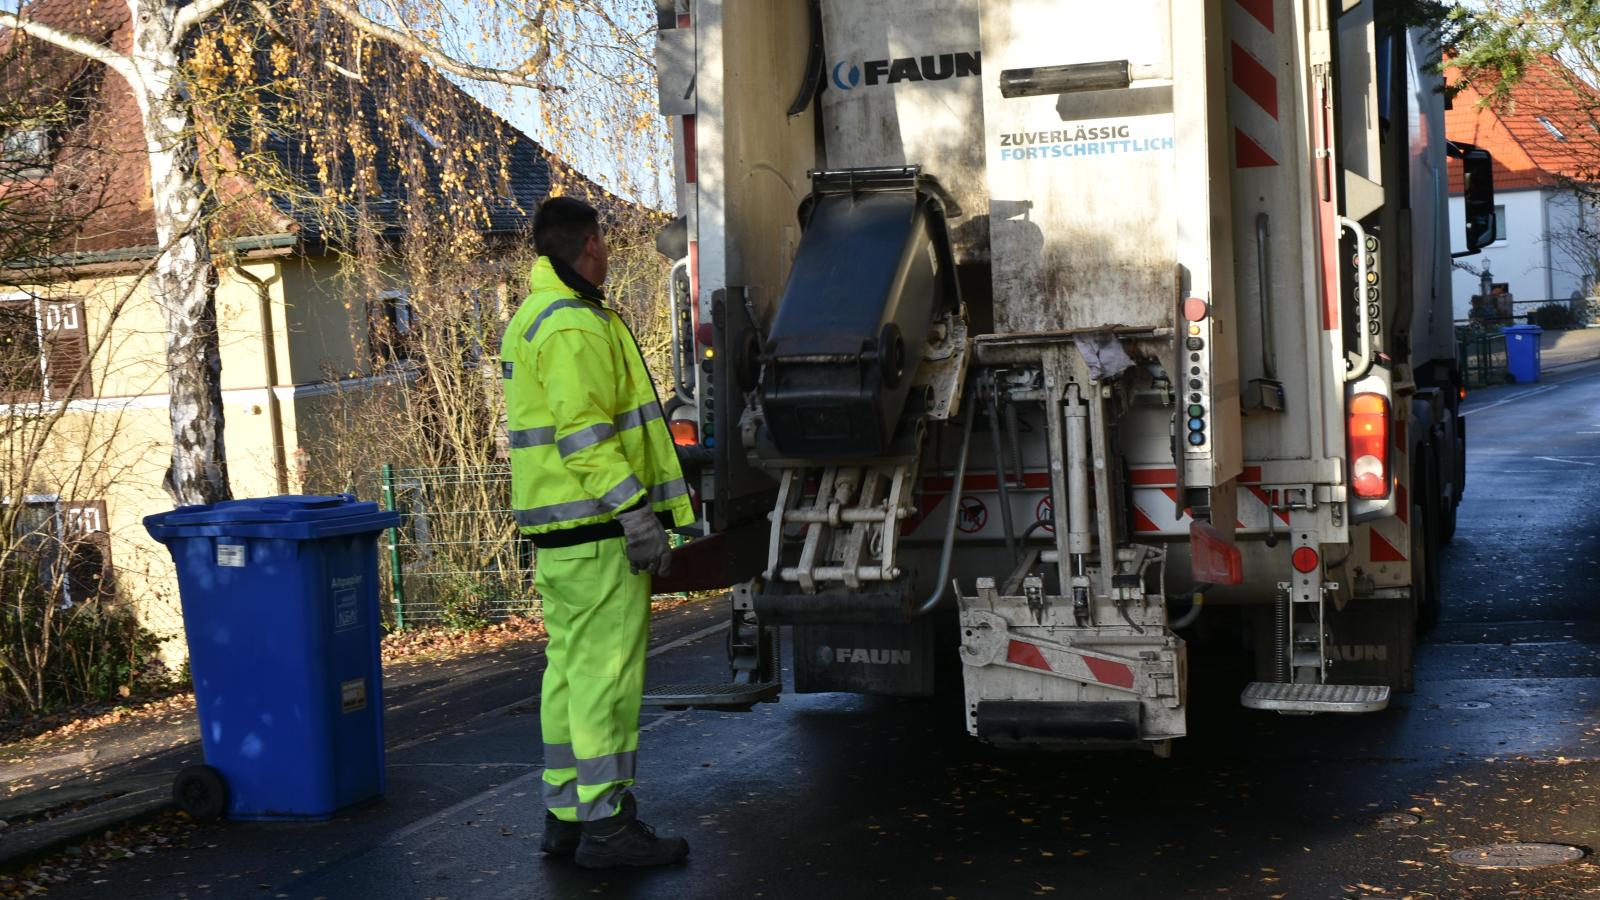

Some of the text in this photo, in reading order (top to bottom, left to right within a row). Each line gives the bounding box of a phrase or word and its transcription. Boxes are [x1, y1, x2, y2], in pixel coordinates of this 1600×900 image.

[864, 50, 982, 86] FAUN
[1000, 125, 1129, 147] ZUVERLÄSSIG
[1001, 137, 1174, 161] FORTSCHRITTLICH
[835, 648, 912, 665] FAUN
[1324, 644, 1387, 661] AUN
